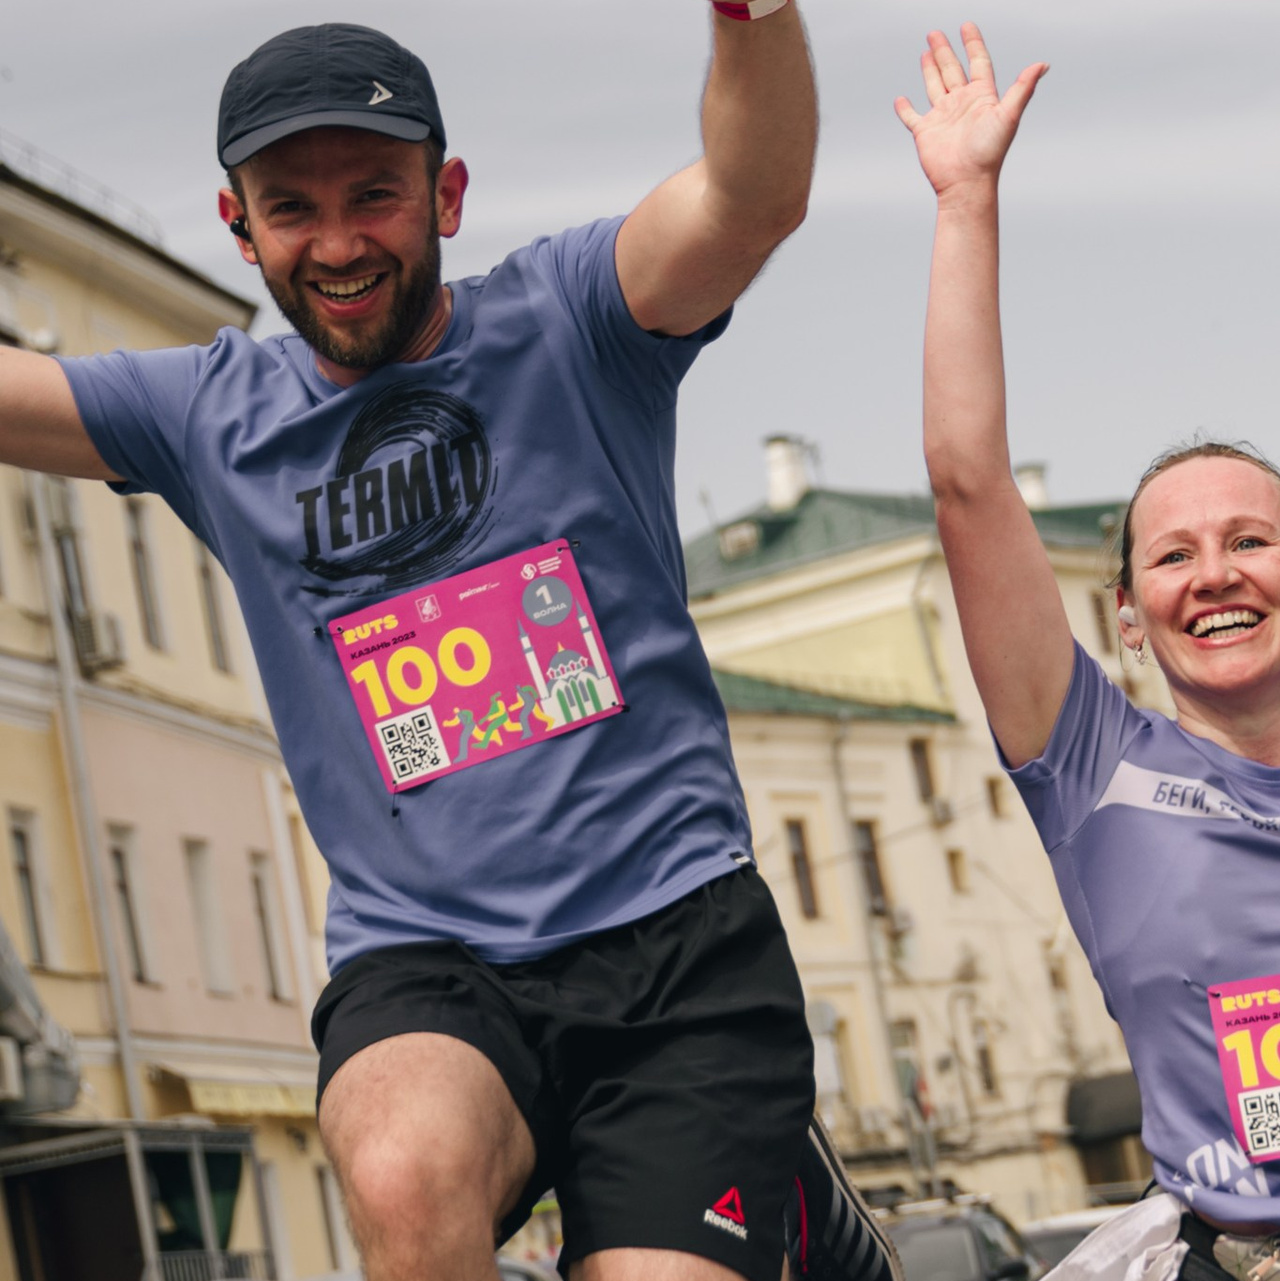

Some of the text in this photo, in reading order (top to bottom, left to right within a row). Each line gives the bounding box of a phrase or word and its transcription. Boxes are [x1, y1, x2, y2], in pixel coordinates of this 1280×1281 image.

[296, 429, 482, 558] TERMIT
[533, 602, 567, 619] ВОЛНА
[535, 584, 553, 605] 1
[342, 614, 399, 646] RUTS
[351, 631, 417, 660] КАЗАНЬ 2023
[350, 627, 492, 718] 100
[1152, 780, 1211, 814] БЕГИ,
[1226, 1015, 1271, 1027] КАЗАНЬ
[703, 1208, 748, 1241] Reebok
